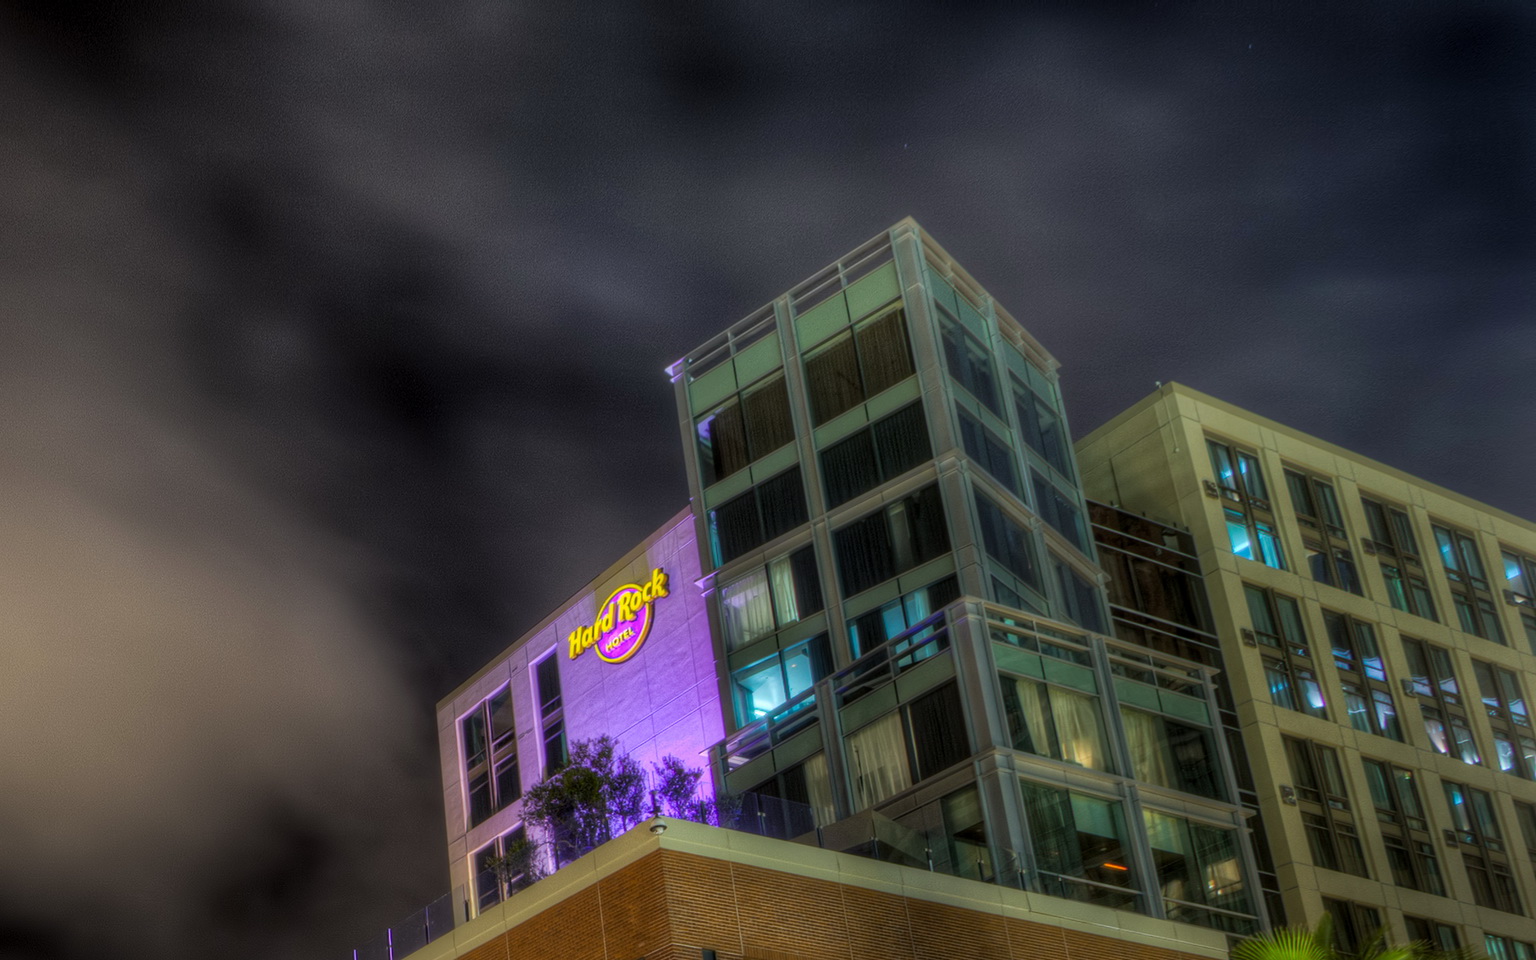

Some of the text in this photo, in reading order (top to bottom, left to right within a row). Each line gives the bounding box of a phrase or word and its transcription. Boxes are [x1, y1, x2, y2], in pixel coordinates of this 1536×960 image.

[568, 567, 669, 659] Hard Rock
[605, 627, 636, 652] HOTEL
